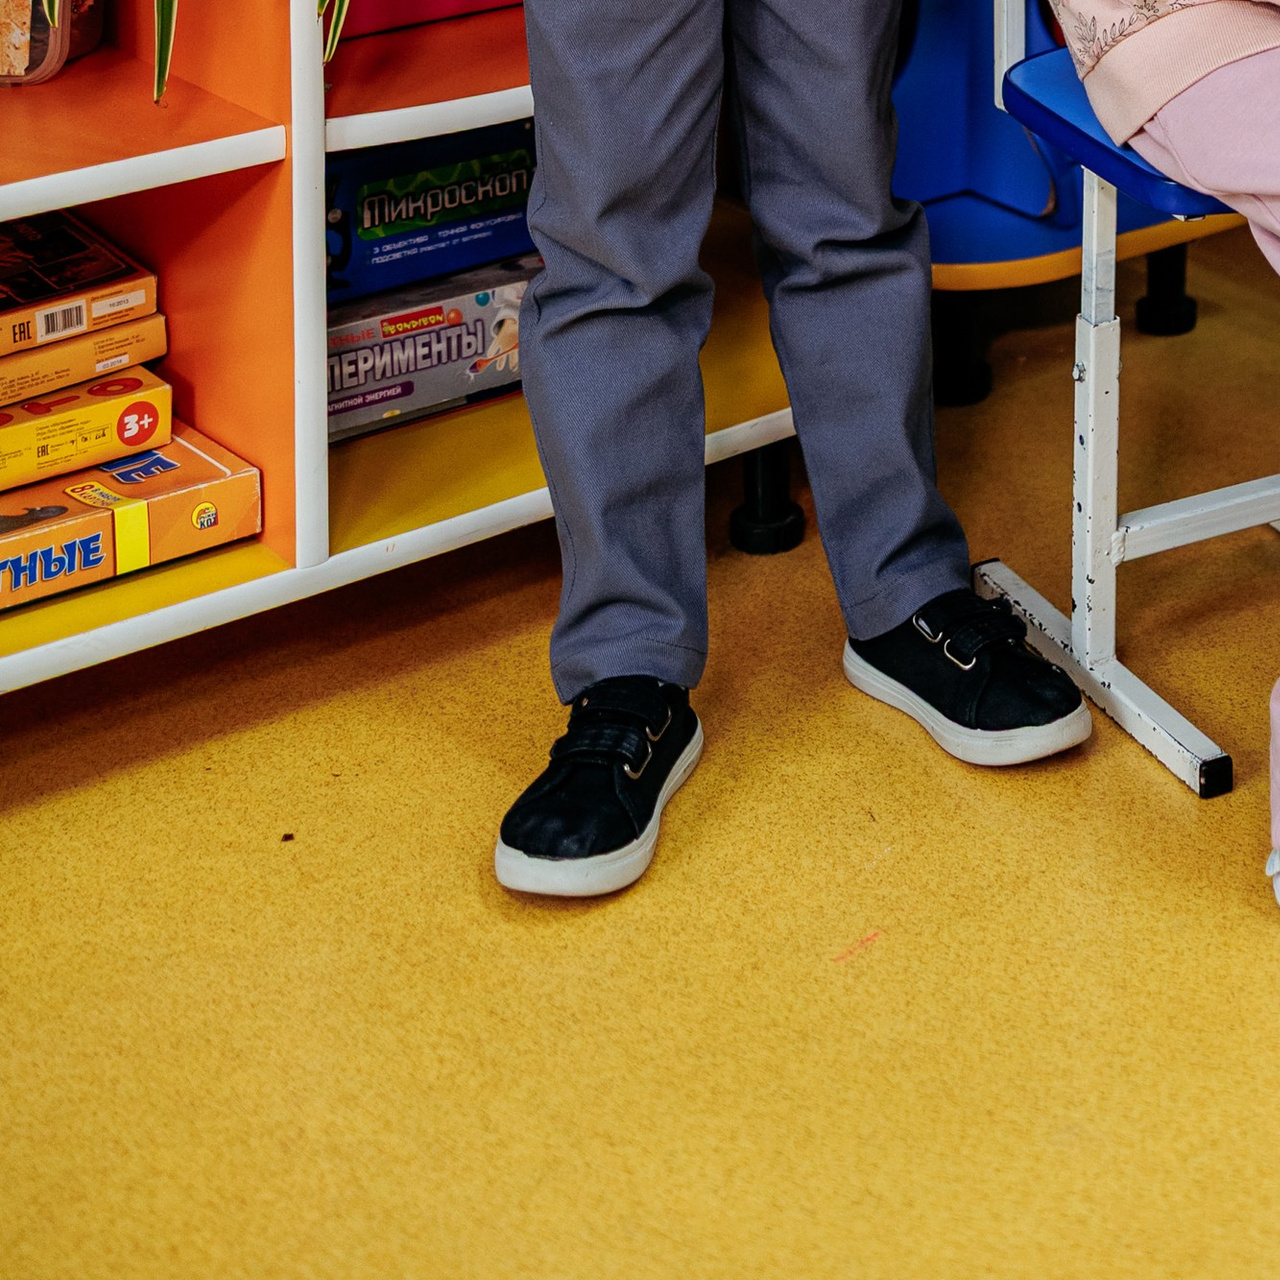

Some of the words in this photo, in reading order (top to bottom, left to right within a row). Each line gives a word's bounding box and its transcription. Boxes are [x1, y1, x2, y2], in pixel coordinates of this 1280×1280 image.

[388, 312, 445, 335] BONDIBON
[328, 319, 485, 391] ПЕРИМЕНТЫ
[123, 414, 153, 438] 3+
